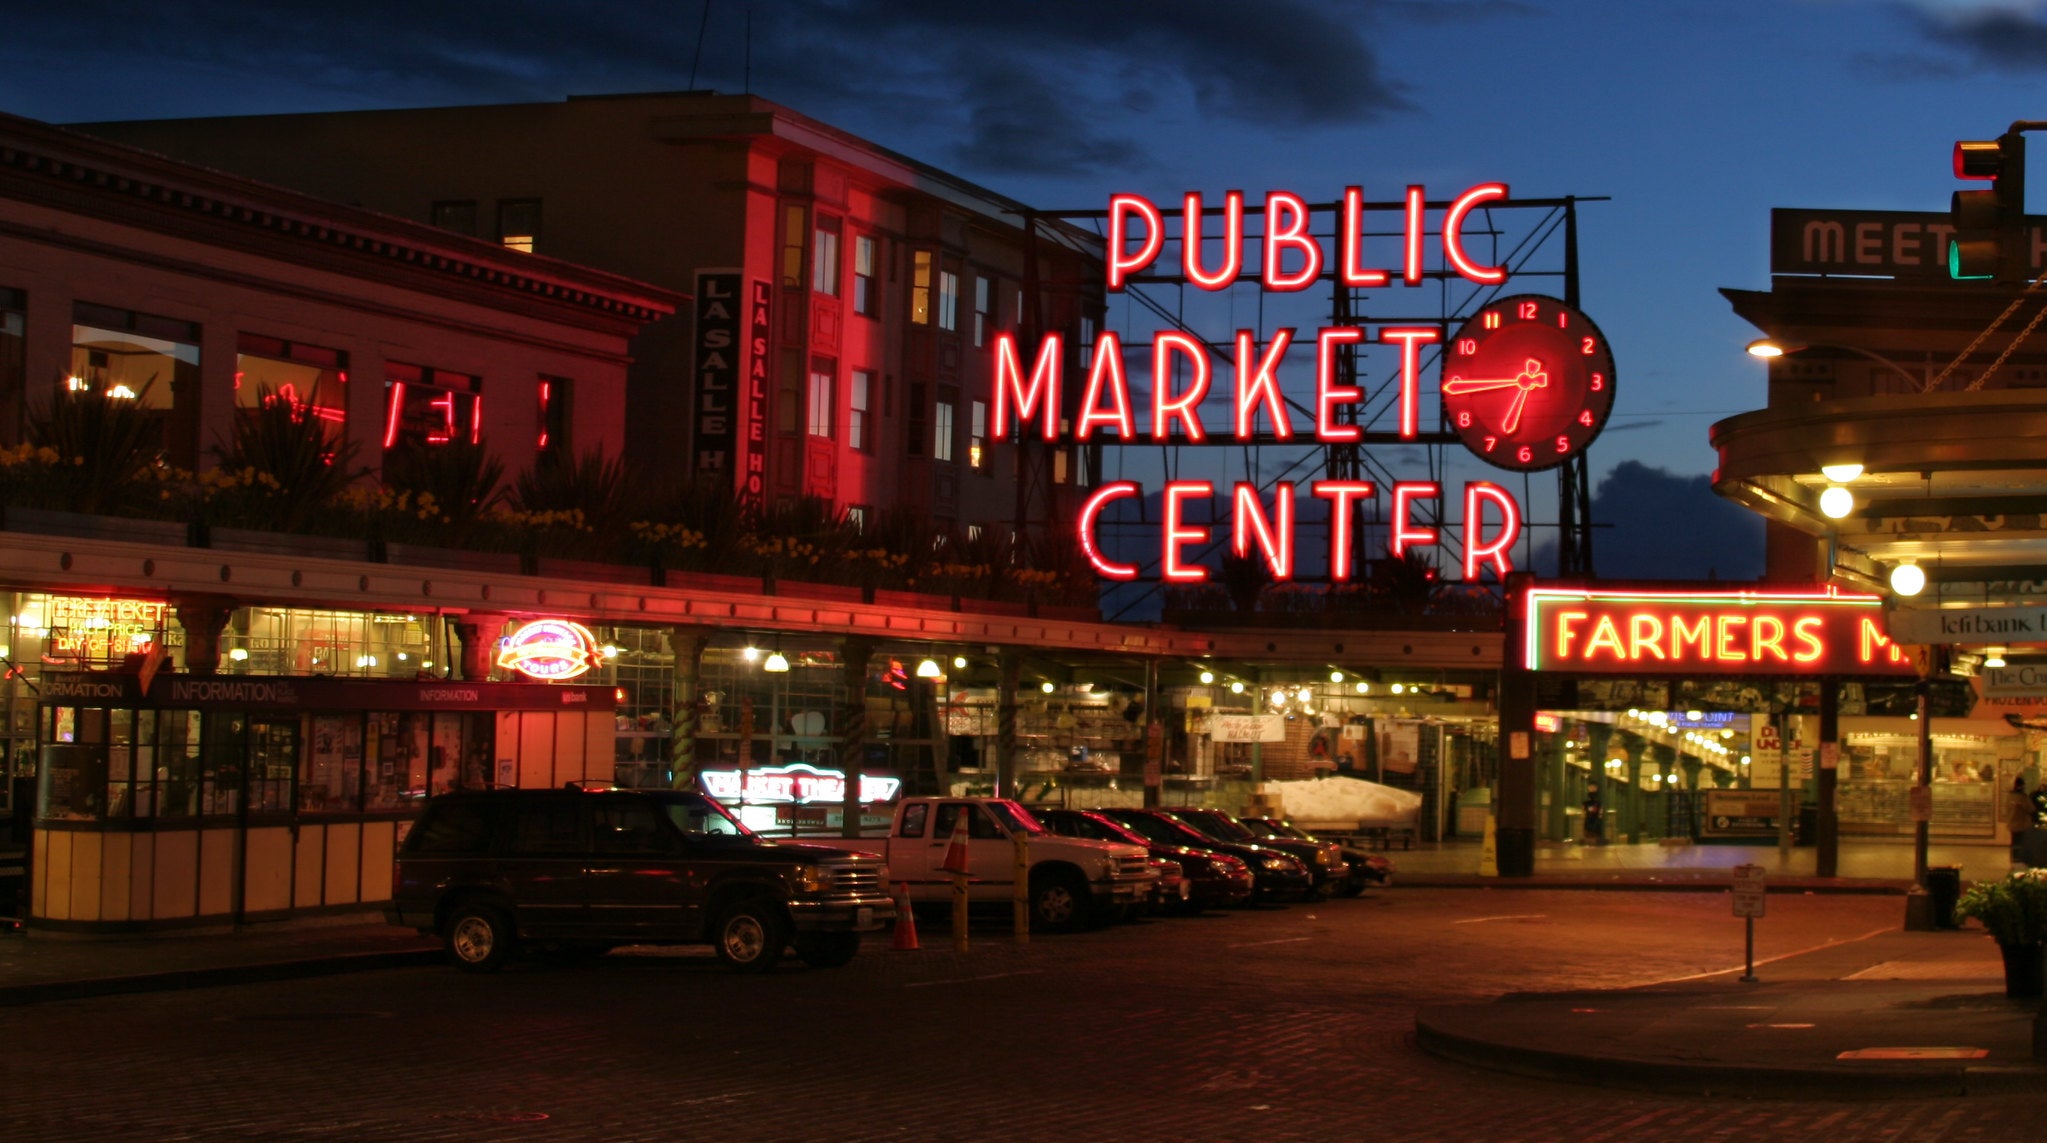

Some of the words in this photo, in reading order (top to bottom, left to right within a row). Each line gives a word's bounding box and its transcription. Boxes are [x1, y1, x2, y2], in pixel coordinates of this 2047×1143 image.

[1107, 182, 1509, 292] PUBLIC
[1803, 220, 1957, 266] MEET
[703, 279, 731, 320] LA
[755, 285, 767, 326] LA
[1485, 313, 1500, 329] 11
[1559, 312, 1566, 328] 1
[1519, 302, 1537, 319] 12
[1459, 339, 1476, 355] 10
[1582, 337, 1594, 354] 2
[701, 329, 732, 435] SALLE
[751, 338, 767, 440] SALLE
[992, 325, 1442, 444] MARKET
[1591, 374, 1602, 391] 3
[1459, 412, 1471, 427] 8
[1578, 410, 1593, 426] 4
[1485, 436, 1496, 452] 7
[1557, 437, 1569, 452] 5
[1519, 447, 1531, 462] 6
[1077, 481, 1522, 581] CENTER
[106, 623, 144, 637] PRICE
[1975, 613, 2032, 635] bank
[1556, 612, 1823, 662] FARMERS
[172, 681, 277, 700] INFORMATION
[420, 689, 478, 702] INFORMATION
